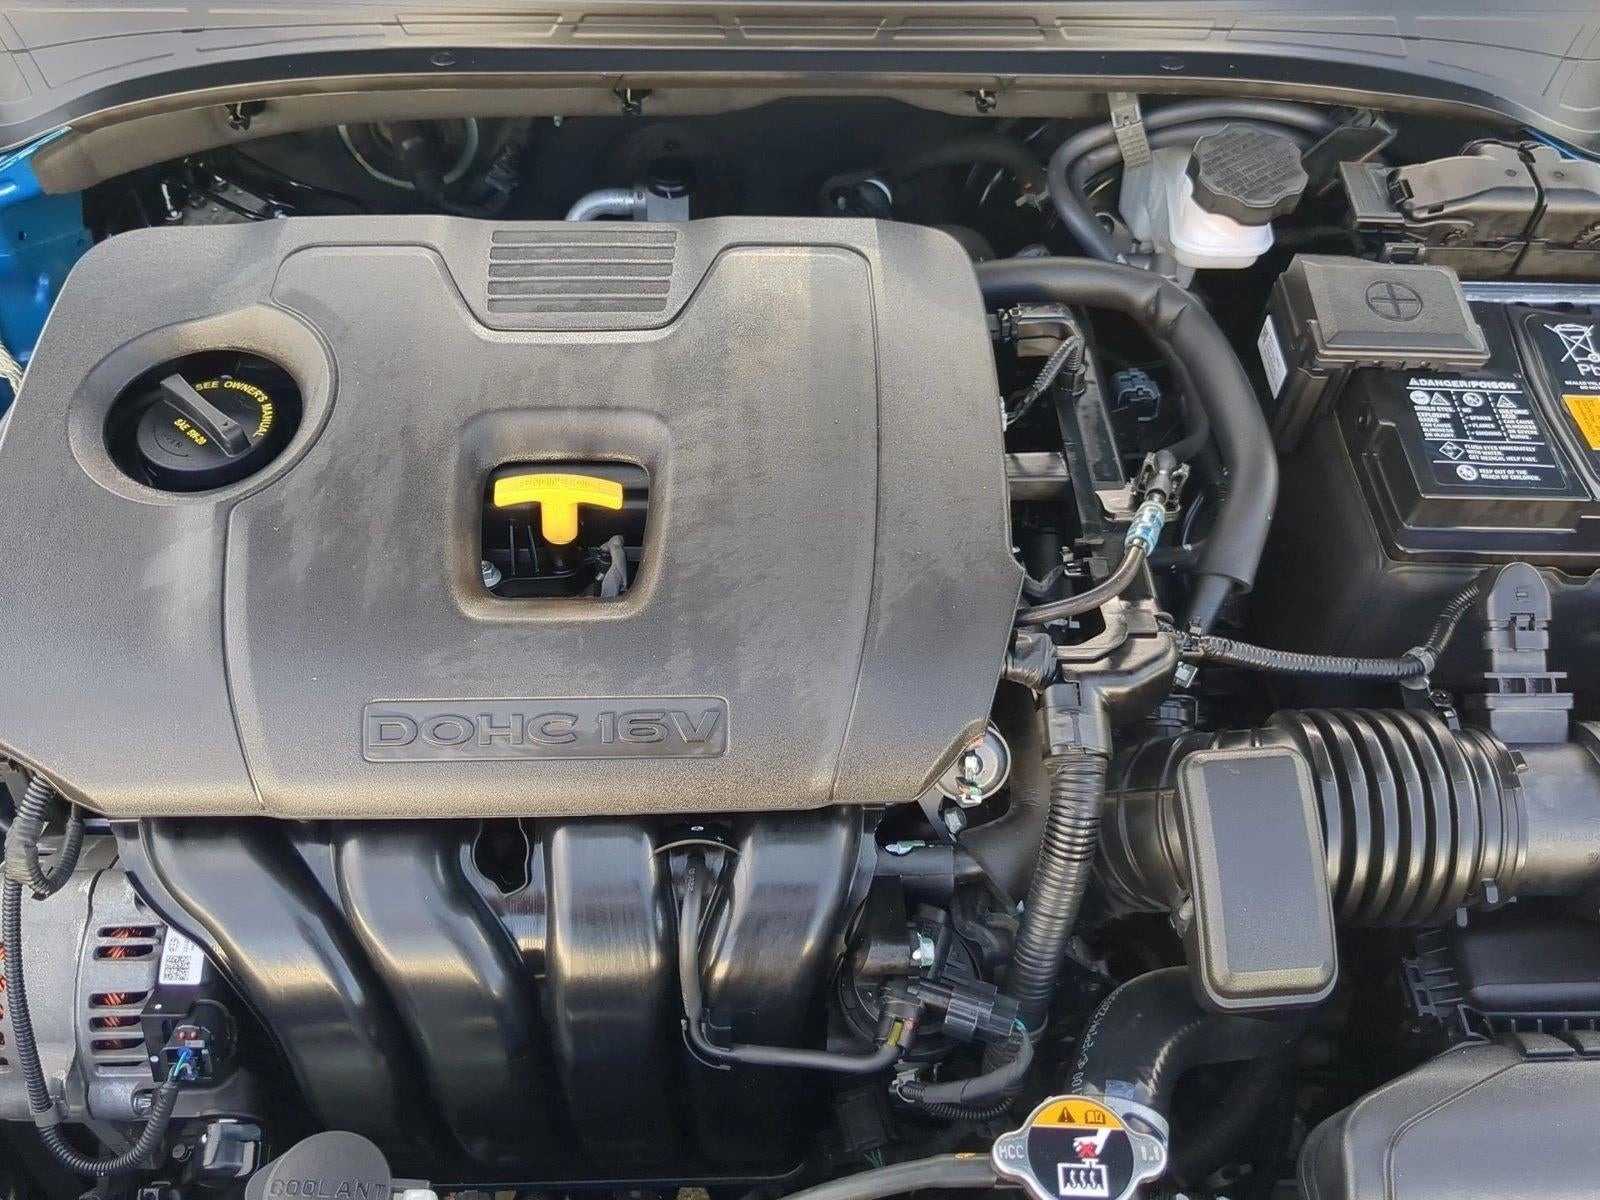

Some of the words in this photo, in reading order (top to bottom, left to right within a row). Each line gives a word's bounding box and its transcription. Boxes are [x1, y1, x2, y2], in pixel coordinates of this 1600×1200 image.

[1418, 379, 1517, 389] DANGER/POISON
[195, 381, 219, 391] SEE
[224, 380, 268, 403] OWNER'S
[252, 403, 274, 438] MANUAL
[174, 418, 190, 431] SAE
[368, 712, 579, 748] DOHC
[599, 710, 722, 745] 16V
[269, 1178, 386, 1200] COOLANT
